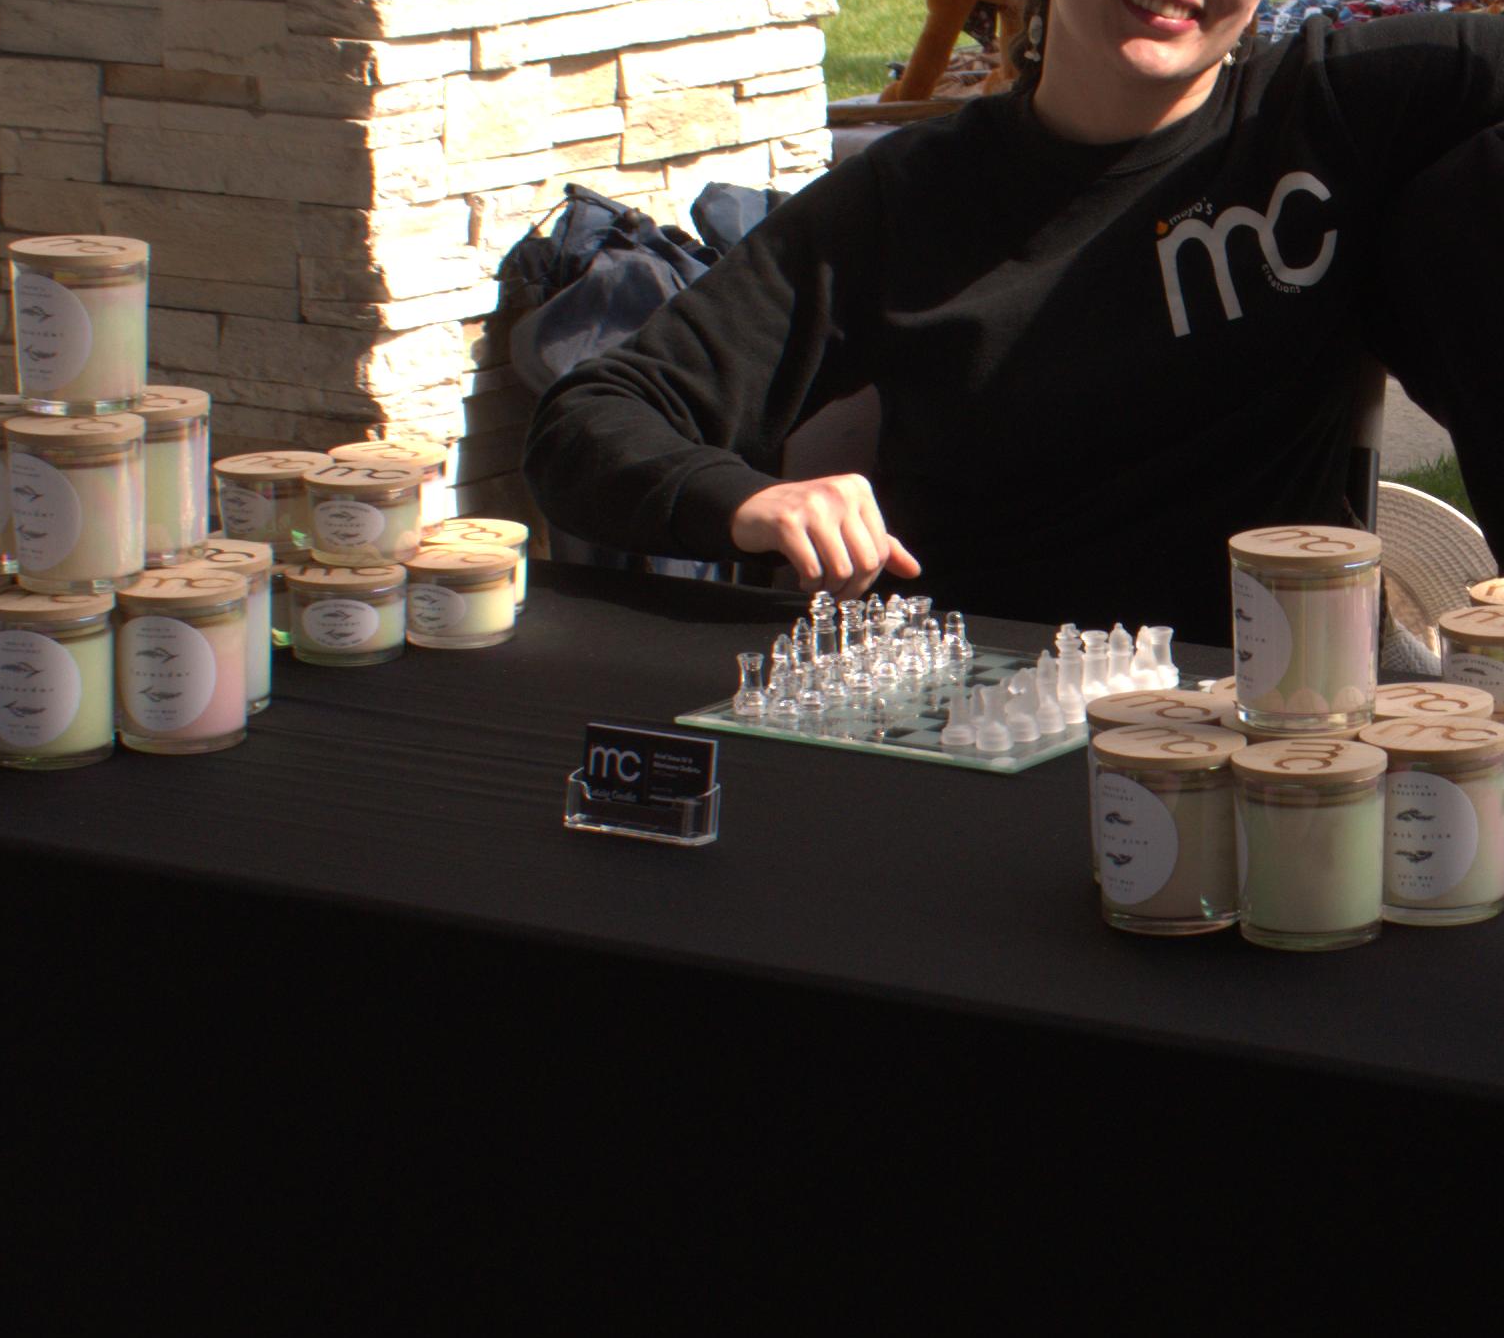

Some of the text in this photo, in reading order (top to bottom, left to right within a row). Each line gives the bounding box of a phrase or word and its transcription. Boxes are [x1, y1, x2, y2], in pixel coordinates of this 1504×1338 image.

[315, 464, 410, 481] mc
[1248, 529, 1356, 553] mc
[1117, 725, 1218, 755] mc
[1376, 722, 1499, 743] mc
[587, 744, 642, 783] mc
